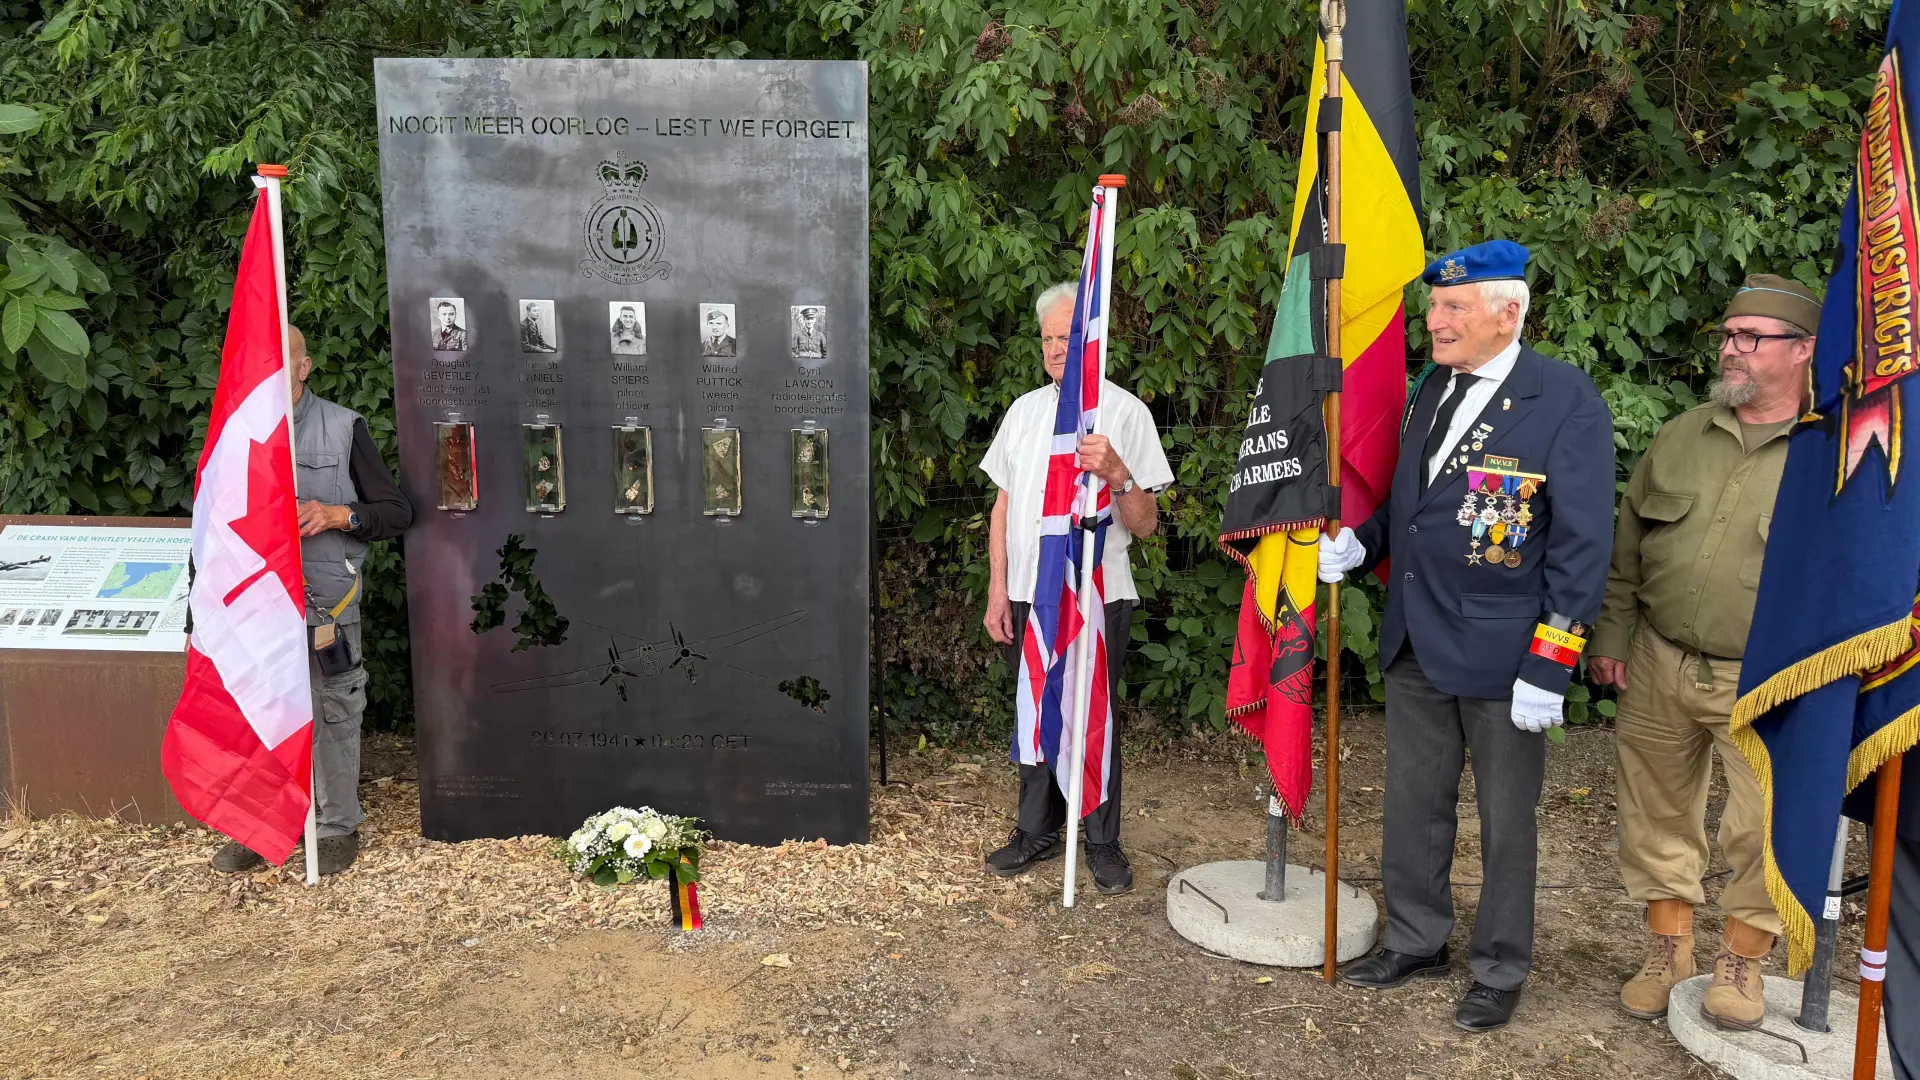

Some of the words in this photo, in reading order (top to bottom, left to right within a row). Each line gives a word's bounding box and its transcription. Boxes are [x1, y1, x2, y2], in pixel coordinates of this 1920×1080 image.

[389, 115, 458, 135] NOOIT
[464, 116, 525, 135] MEER
[531, 116, 630, 136] OORLOG
[655, 118, 712, 137] LEST
[719, 118, 756, 137] WE
[762, 119, 855, 138] FORGET
[1867, 213, 1913, 377] DISTRICTS
[431, 358, 471, 370] Douglas
[612, 362, 648, 372] William
[702, 364, 738, 374] Wilfred
[423, 371, 480, 381] BEVERLEY
[798, 366, 821, 378] Cyril
[611, 375, 649, 385] SPIERS
[697, 377, 742, 387] PUTTICK
[785, 379, 833, 389] LAWSON
[415, 384, 490, 396] radiotelegrist
[527, 386, 555, 397] iloot
[617, 388, 645, 399] piloot
[702, 391, 739, 400] tweede
[419, 396, 488, 407] boordschutter
[771, 392, 847, 404] radiotelegrafist
[615, 401, 650, 411] officier
[707, 403, 735, 414] piloot
[775, 405, 844, 415] boordschutter
[1243, 458, 1302, 486] ARMEES
[1545, 630, 1570, 644] NVVS
[1541, 643, 1560, 655] AFD
[531, 731, 628, 747] 2607.1941
[711, 734, 753, 750] CET
